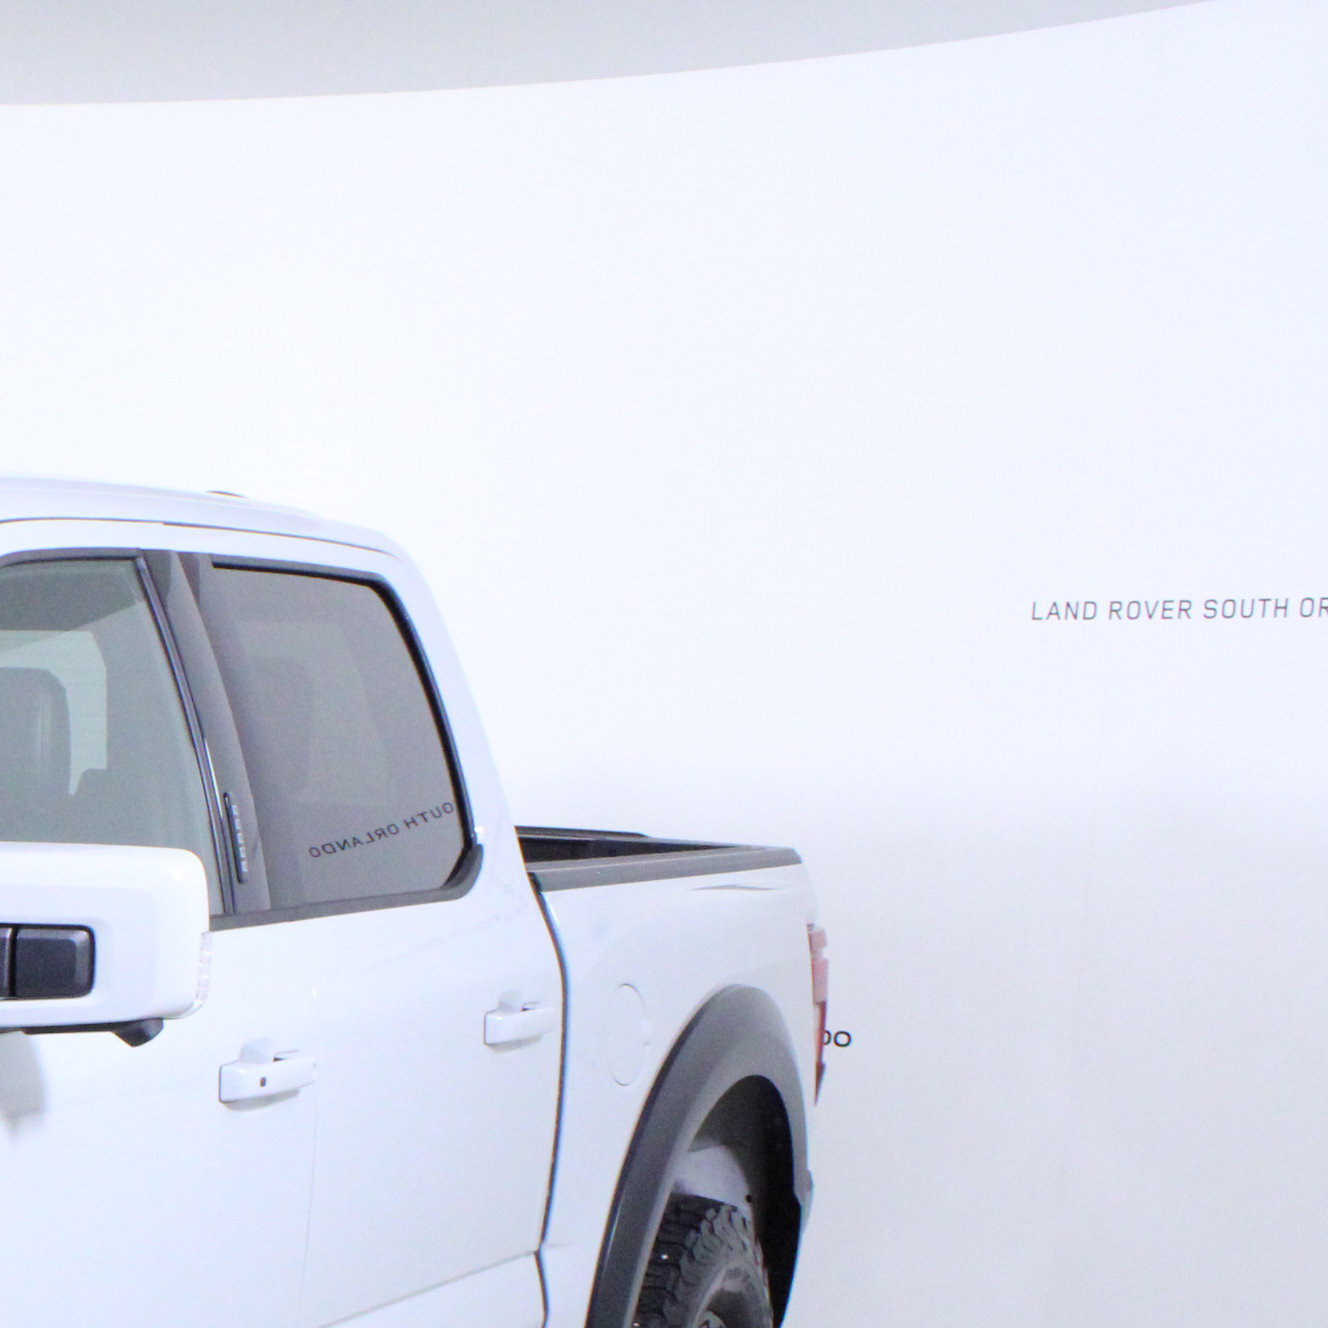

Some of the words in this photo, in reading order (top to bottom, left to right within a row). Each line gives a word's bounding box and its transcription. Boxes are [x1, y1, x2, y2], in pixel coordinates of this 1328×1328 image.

[1031, 600, 1098, 621] LAND
[1108, 599, 1193, 620] ROVER
[1202, 598, 1289, 619] SOUTH
